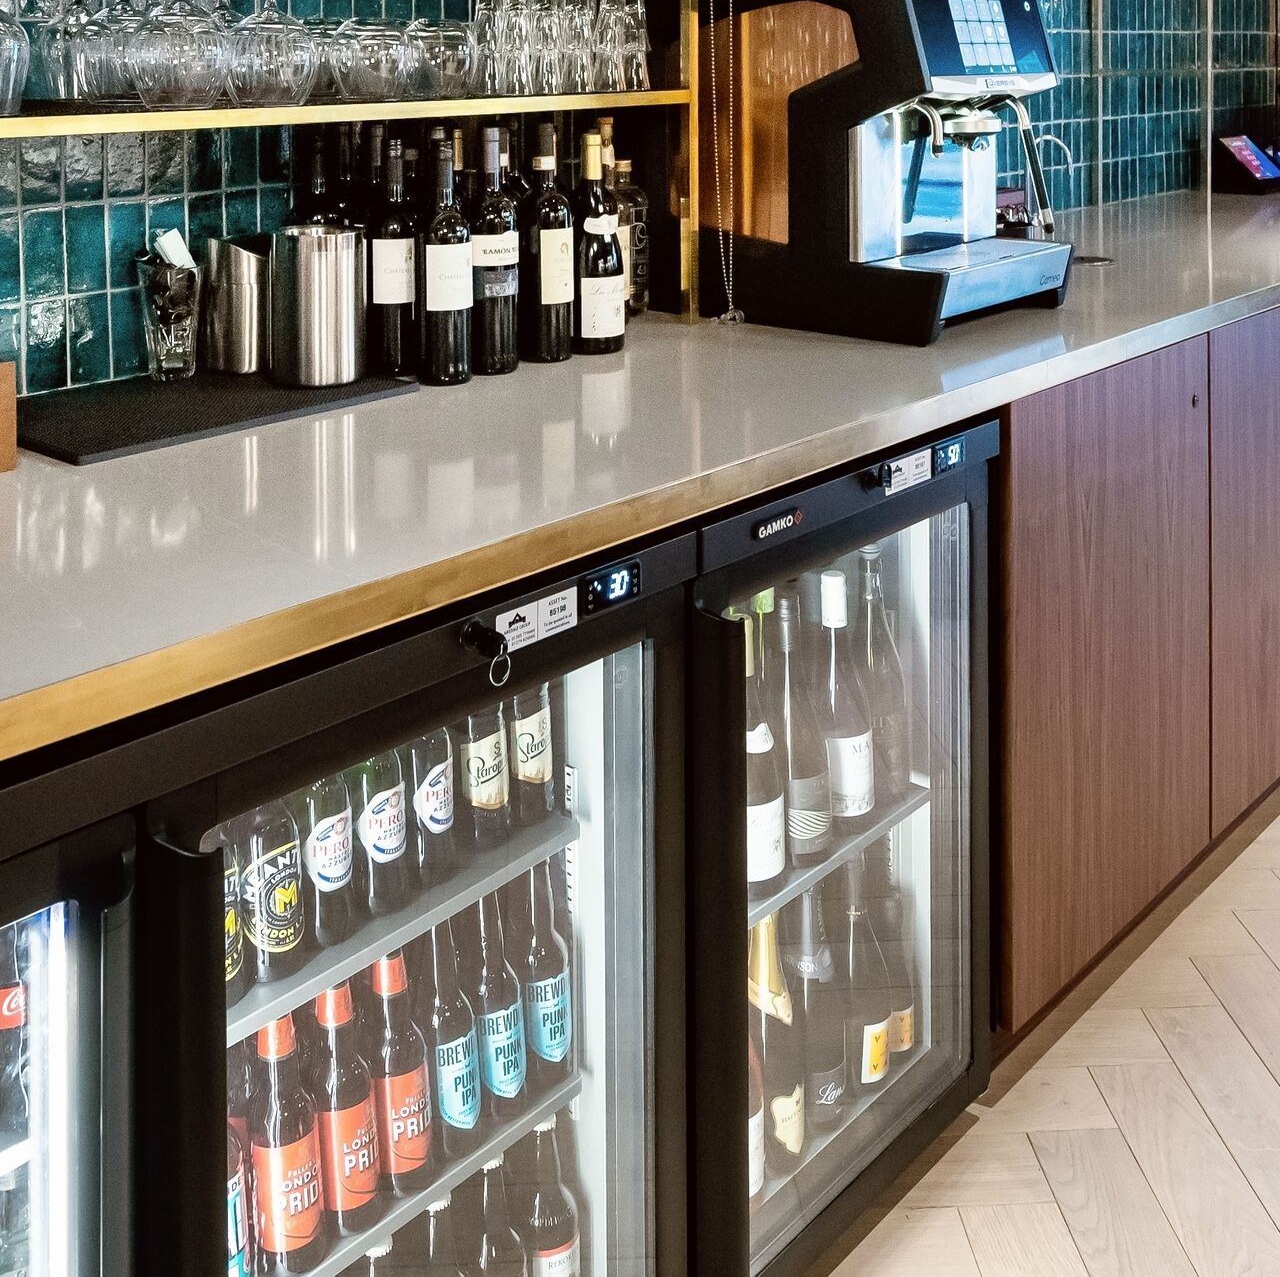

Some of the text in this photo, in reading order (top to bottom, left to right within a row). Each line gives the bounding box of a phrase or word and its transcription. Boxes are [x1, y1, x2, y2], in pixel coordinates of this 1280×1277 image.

[758, 514, 794, 539] GAMKO
[548, 596, 560, 606] ASSET
[273, 879, 298, 916] M
[549, 1024, 565, 1042] IPA
[502, 1055, 520, 1077] IPA
[461, 1086, 477, 1107] IPA
